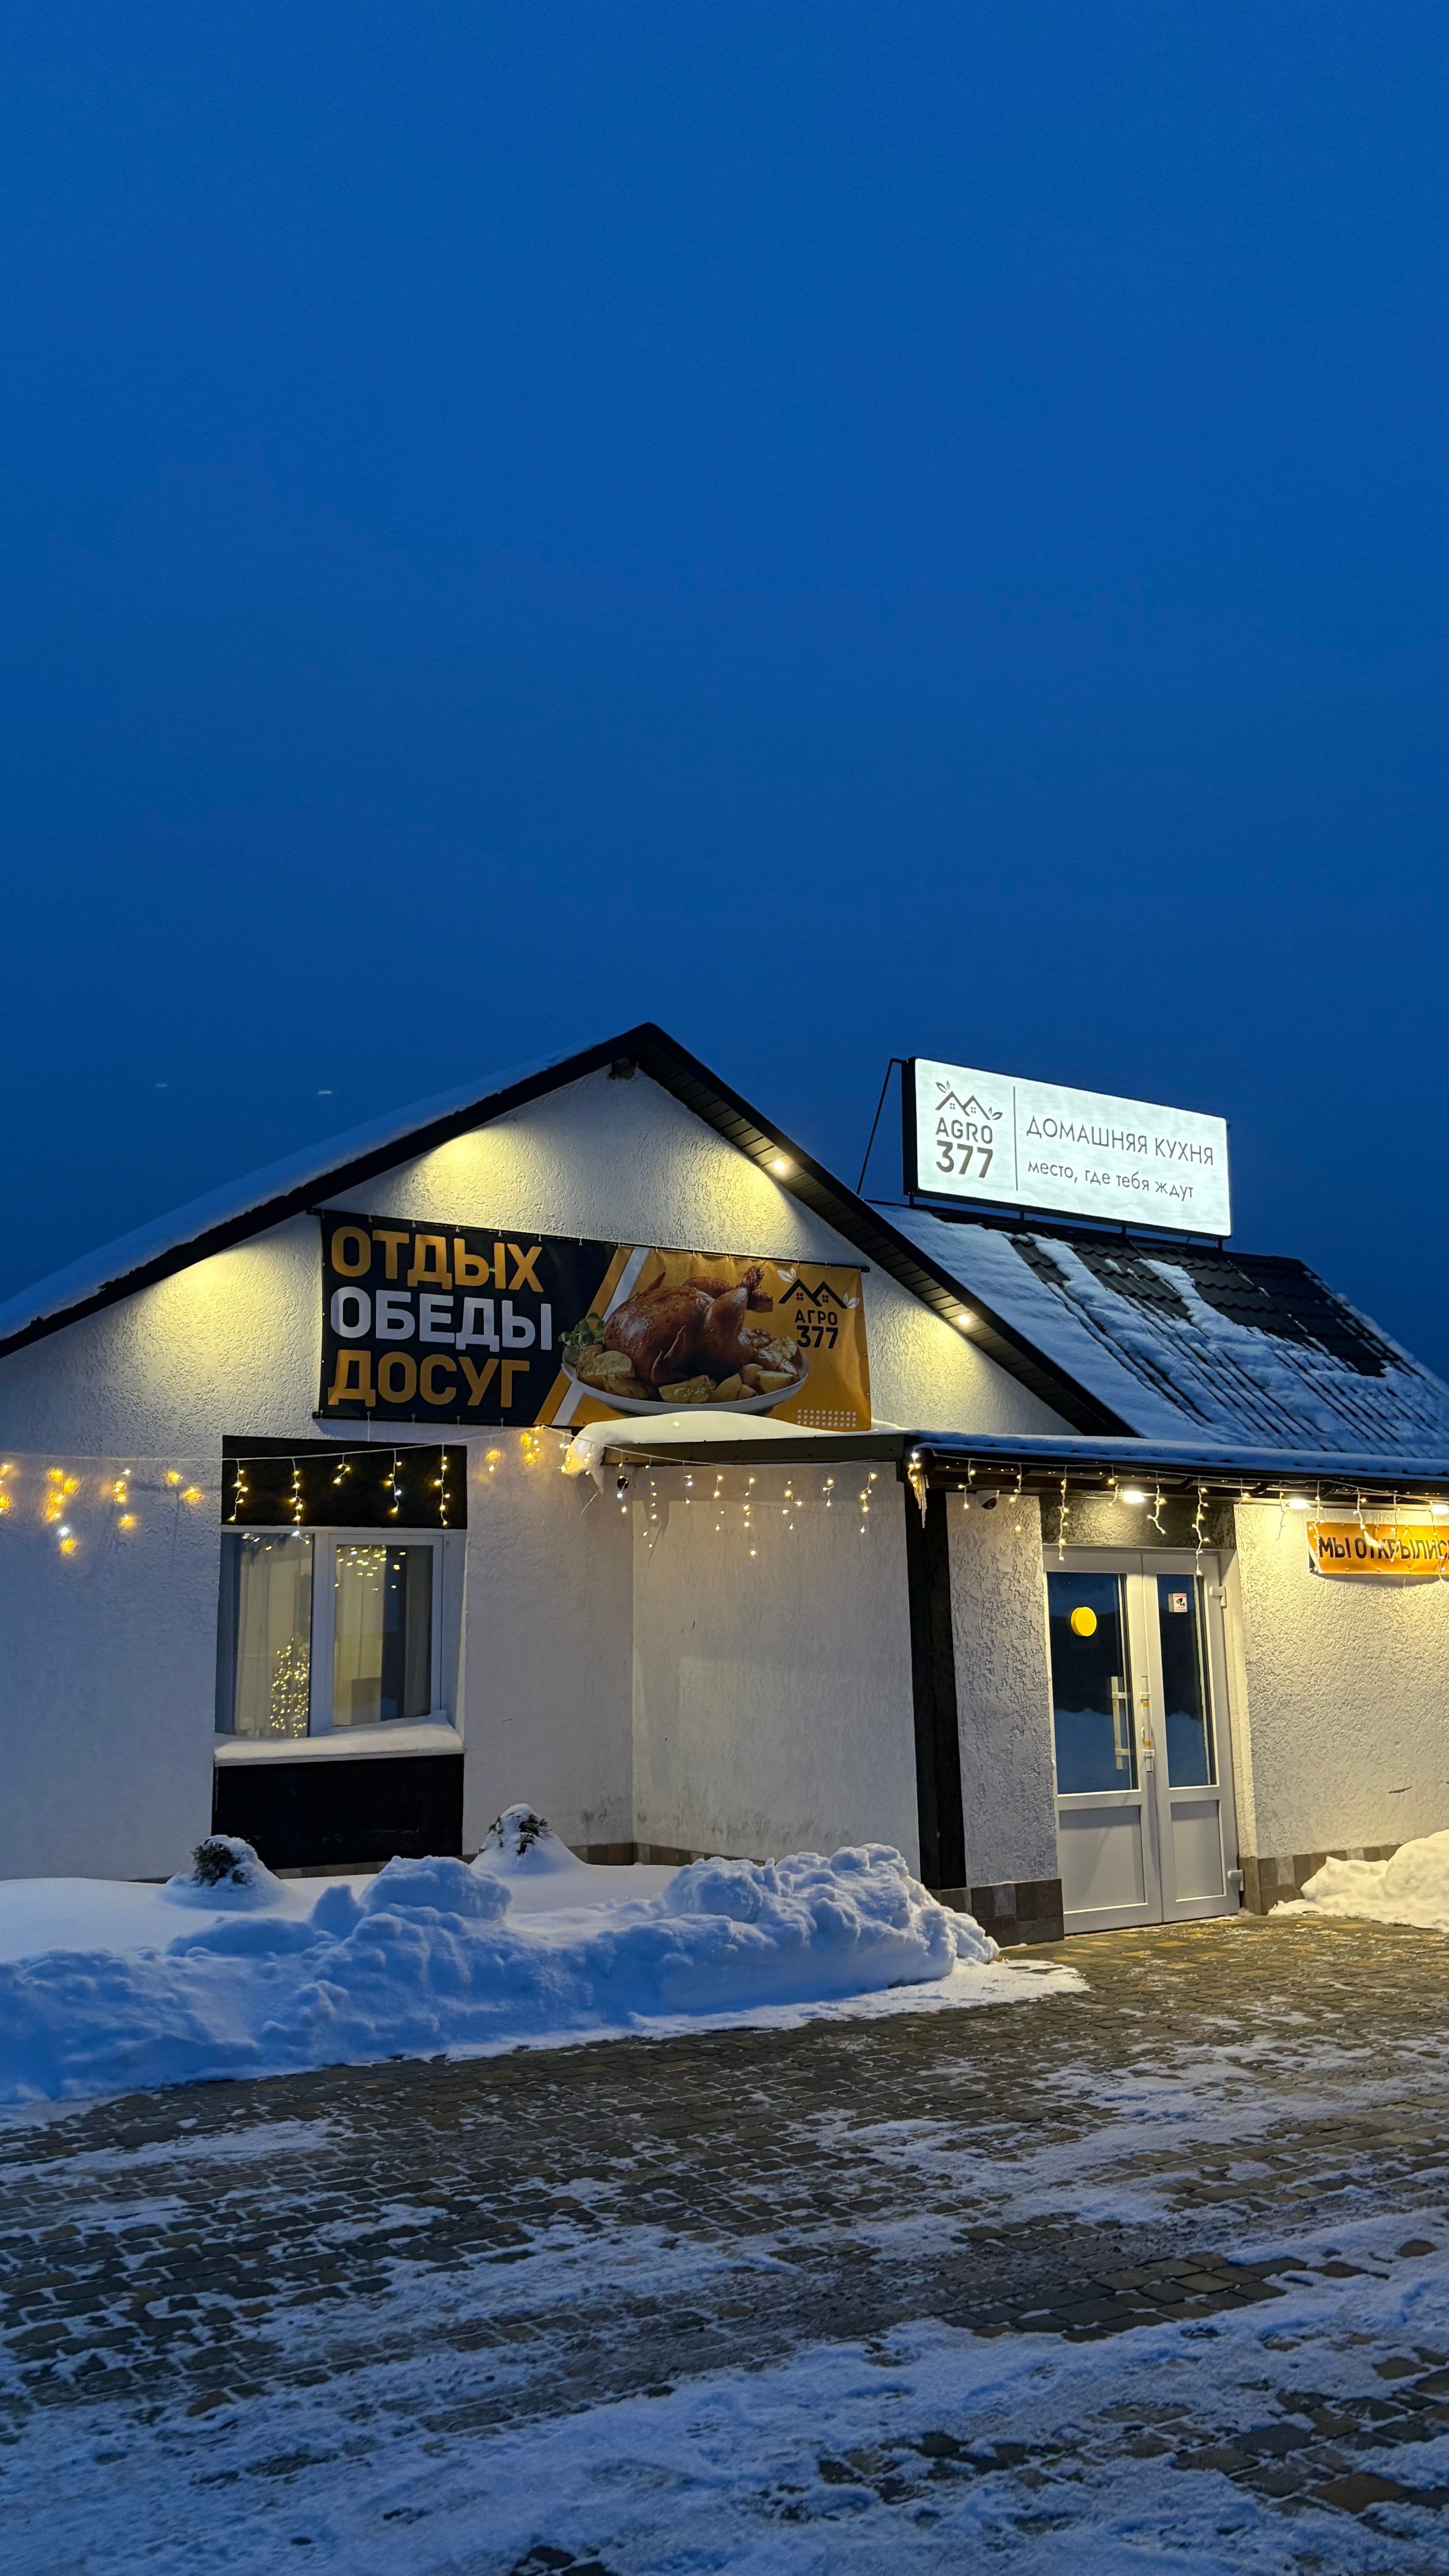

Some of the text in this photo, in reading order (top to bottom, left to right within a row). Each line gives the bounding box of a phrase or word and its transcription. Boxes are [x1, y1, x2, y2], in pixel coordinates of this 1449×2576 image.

[935, 1117, 993, 1145] AGRO
[1026, 1114, 1214, 1166] ДОМАШНЯЯ КУХНЯ
[935, 1140, 994, 1179] 377
[1027, 1160, 1194, 1202] место, где тебя ждут
[331, 1225, 544, 1293] ОТДЫХ
[330, 1286, 552, 1352] ОБЕДЫ
[795, 1309, 838, 1326] АГРО
[796, 1325, 839, 1349] 377
[327, 1349, 530, 1408] ДОСУГ
[1318, 1536, 1352, 1559] МЫ
